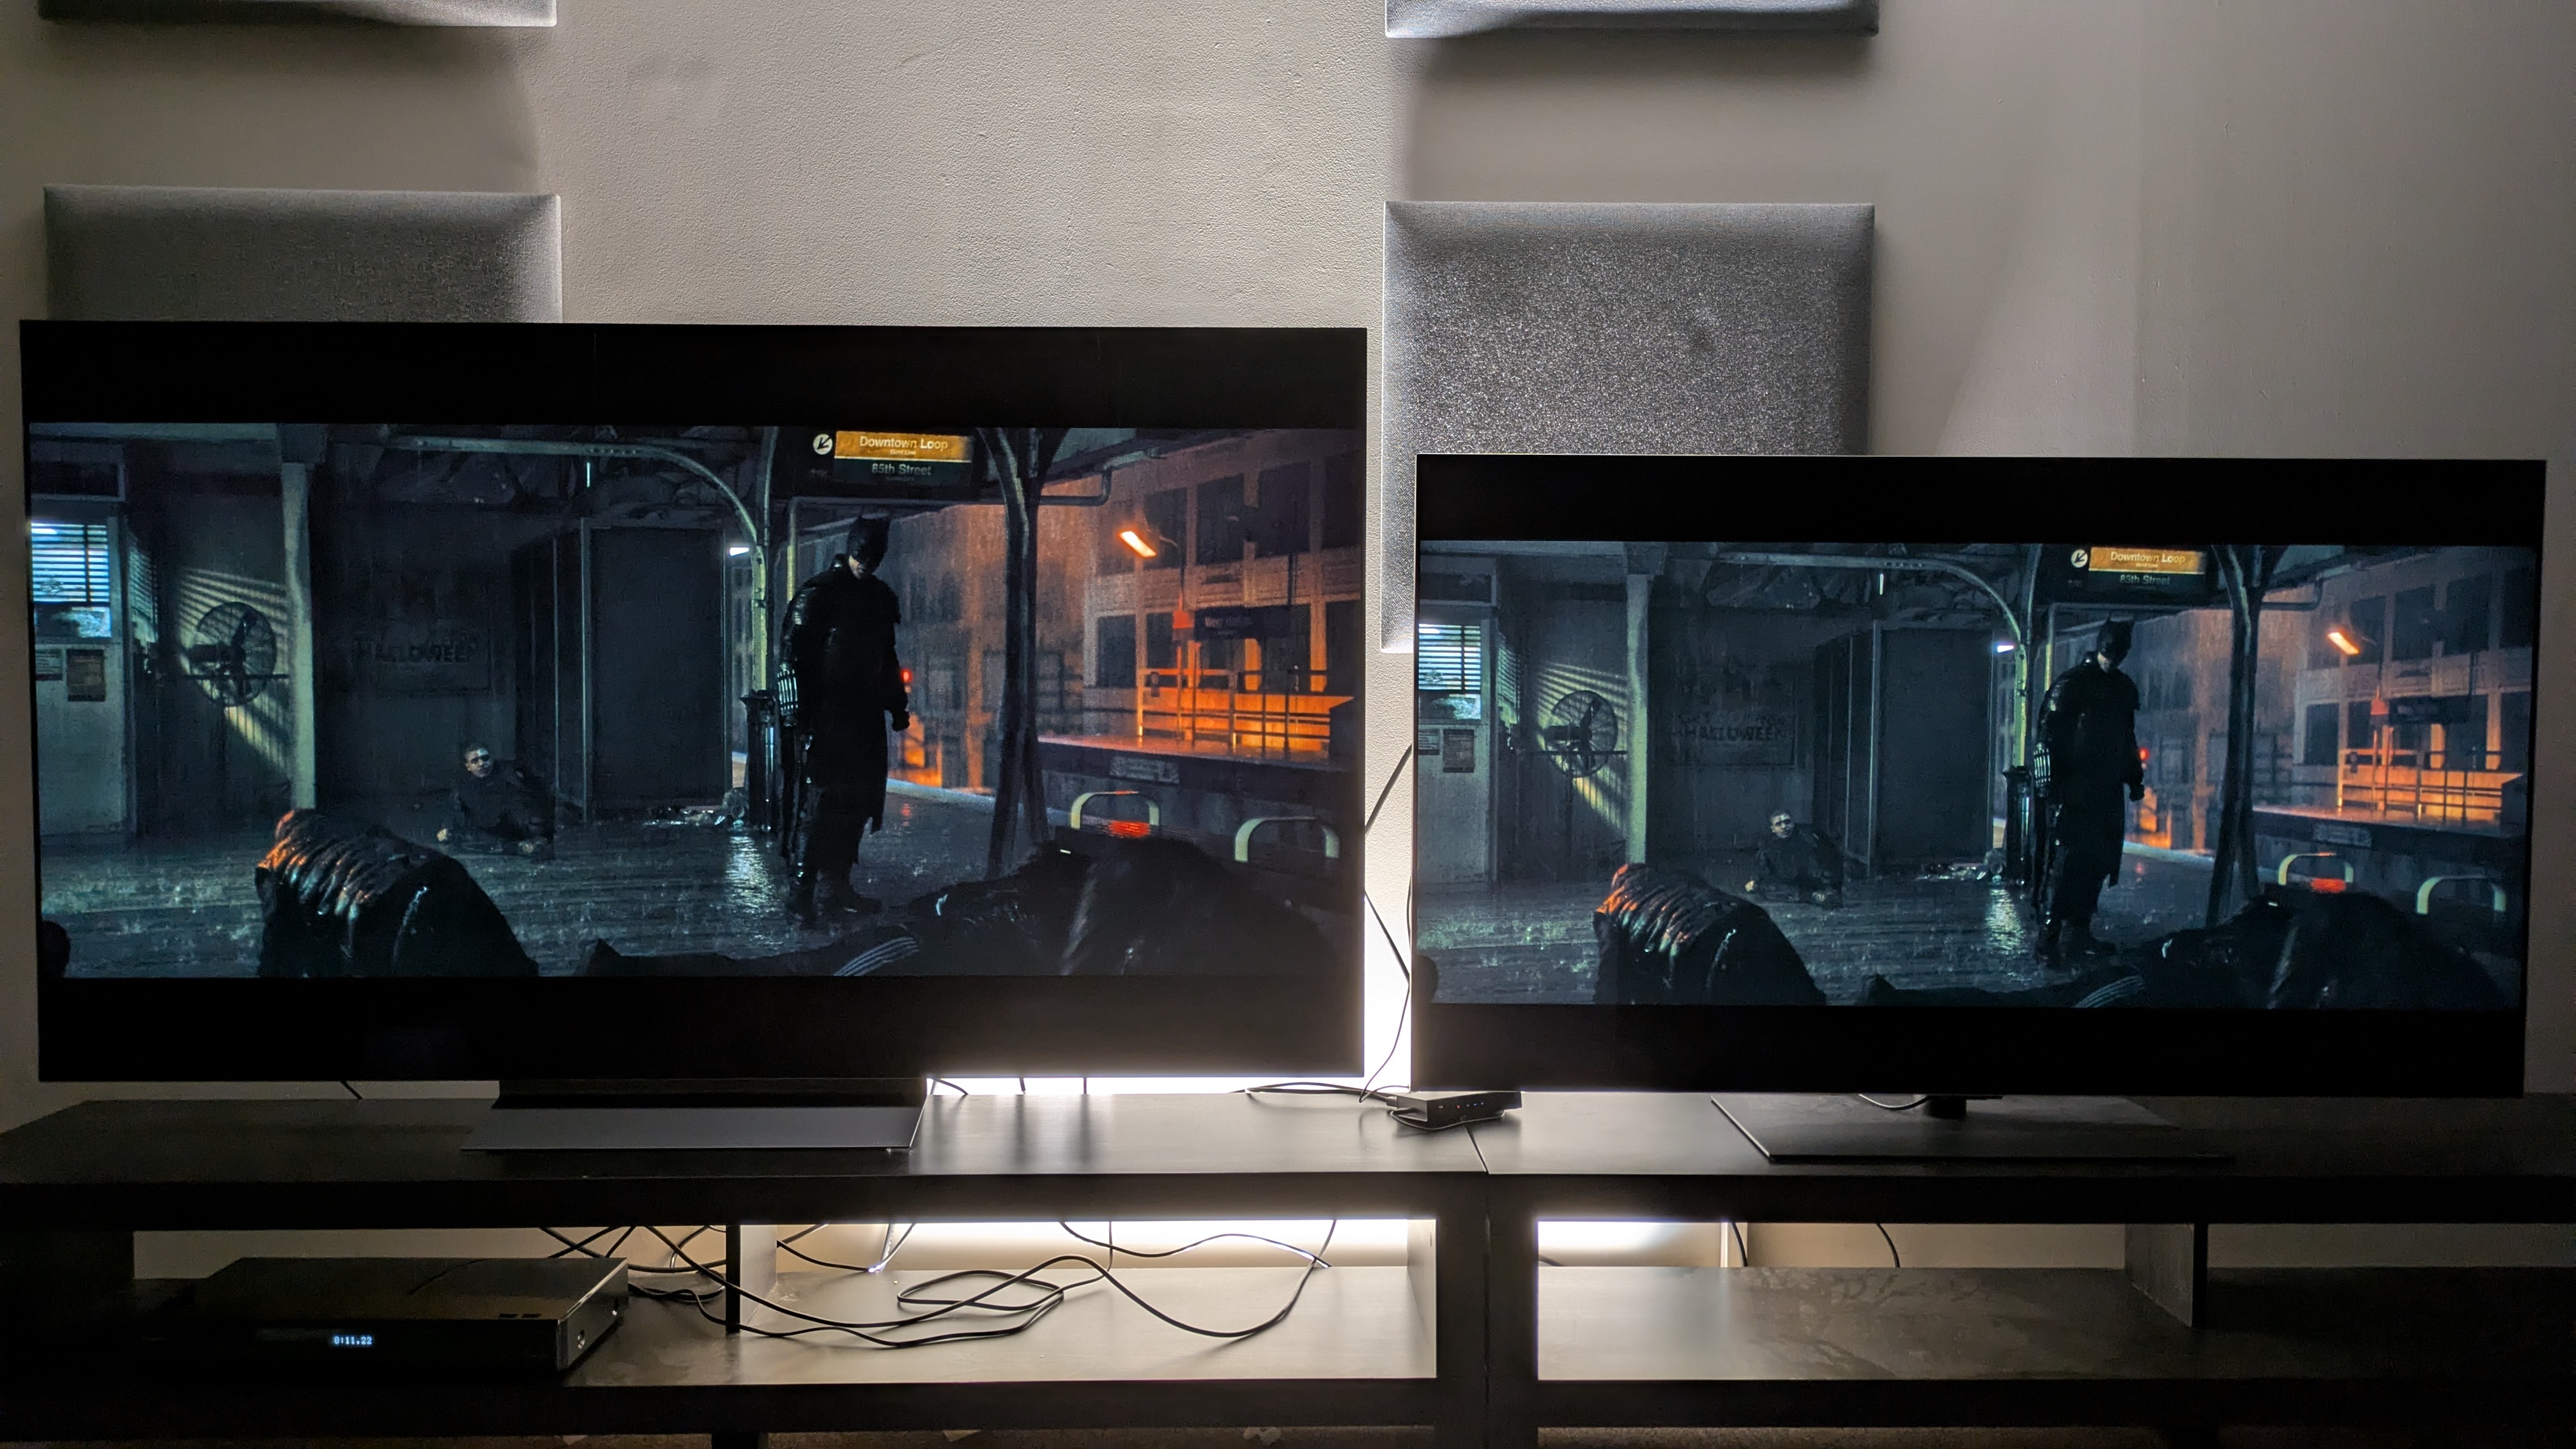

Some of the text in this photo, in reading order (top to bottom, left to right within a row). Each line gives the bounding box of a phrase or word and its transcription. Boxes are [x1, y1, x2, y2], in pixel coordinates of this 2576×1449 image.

[859, 436, 948, 451] Downtown Loop
[871, 463, 931, 475] 85th Street
[2110, 551, 2186, 564] Downtown Loop
[2120, 574, 2170, 586] 85th Street
[334, 1336, 372, 1345] 0:11.22
